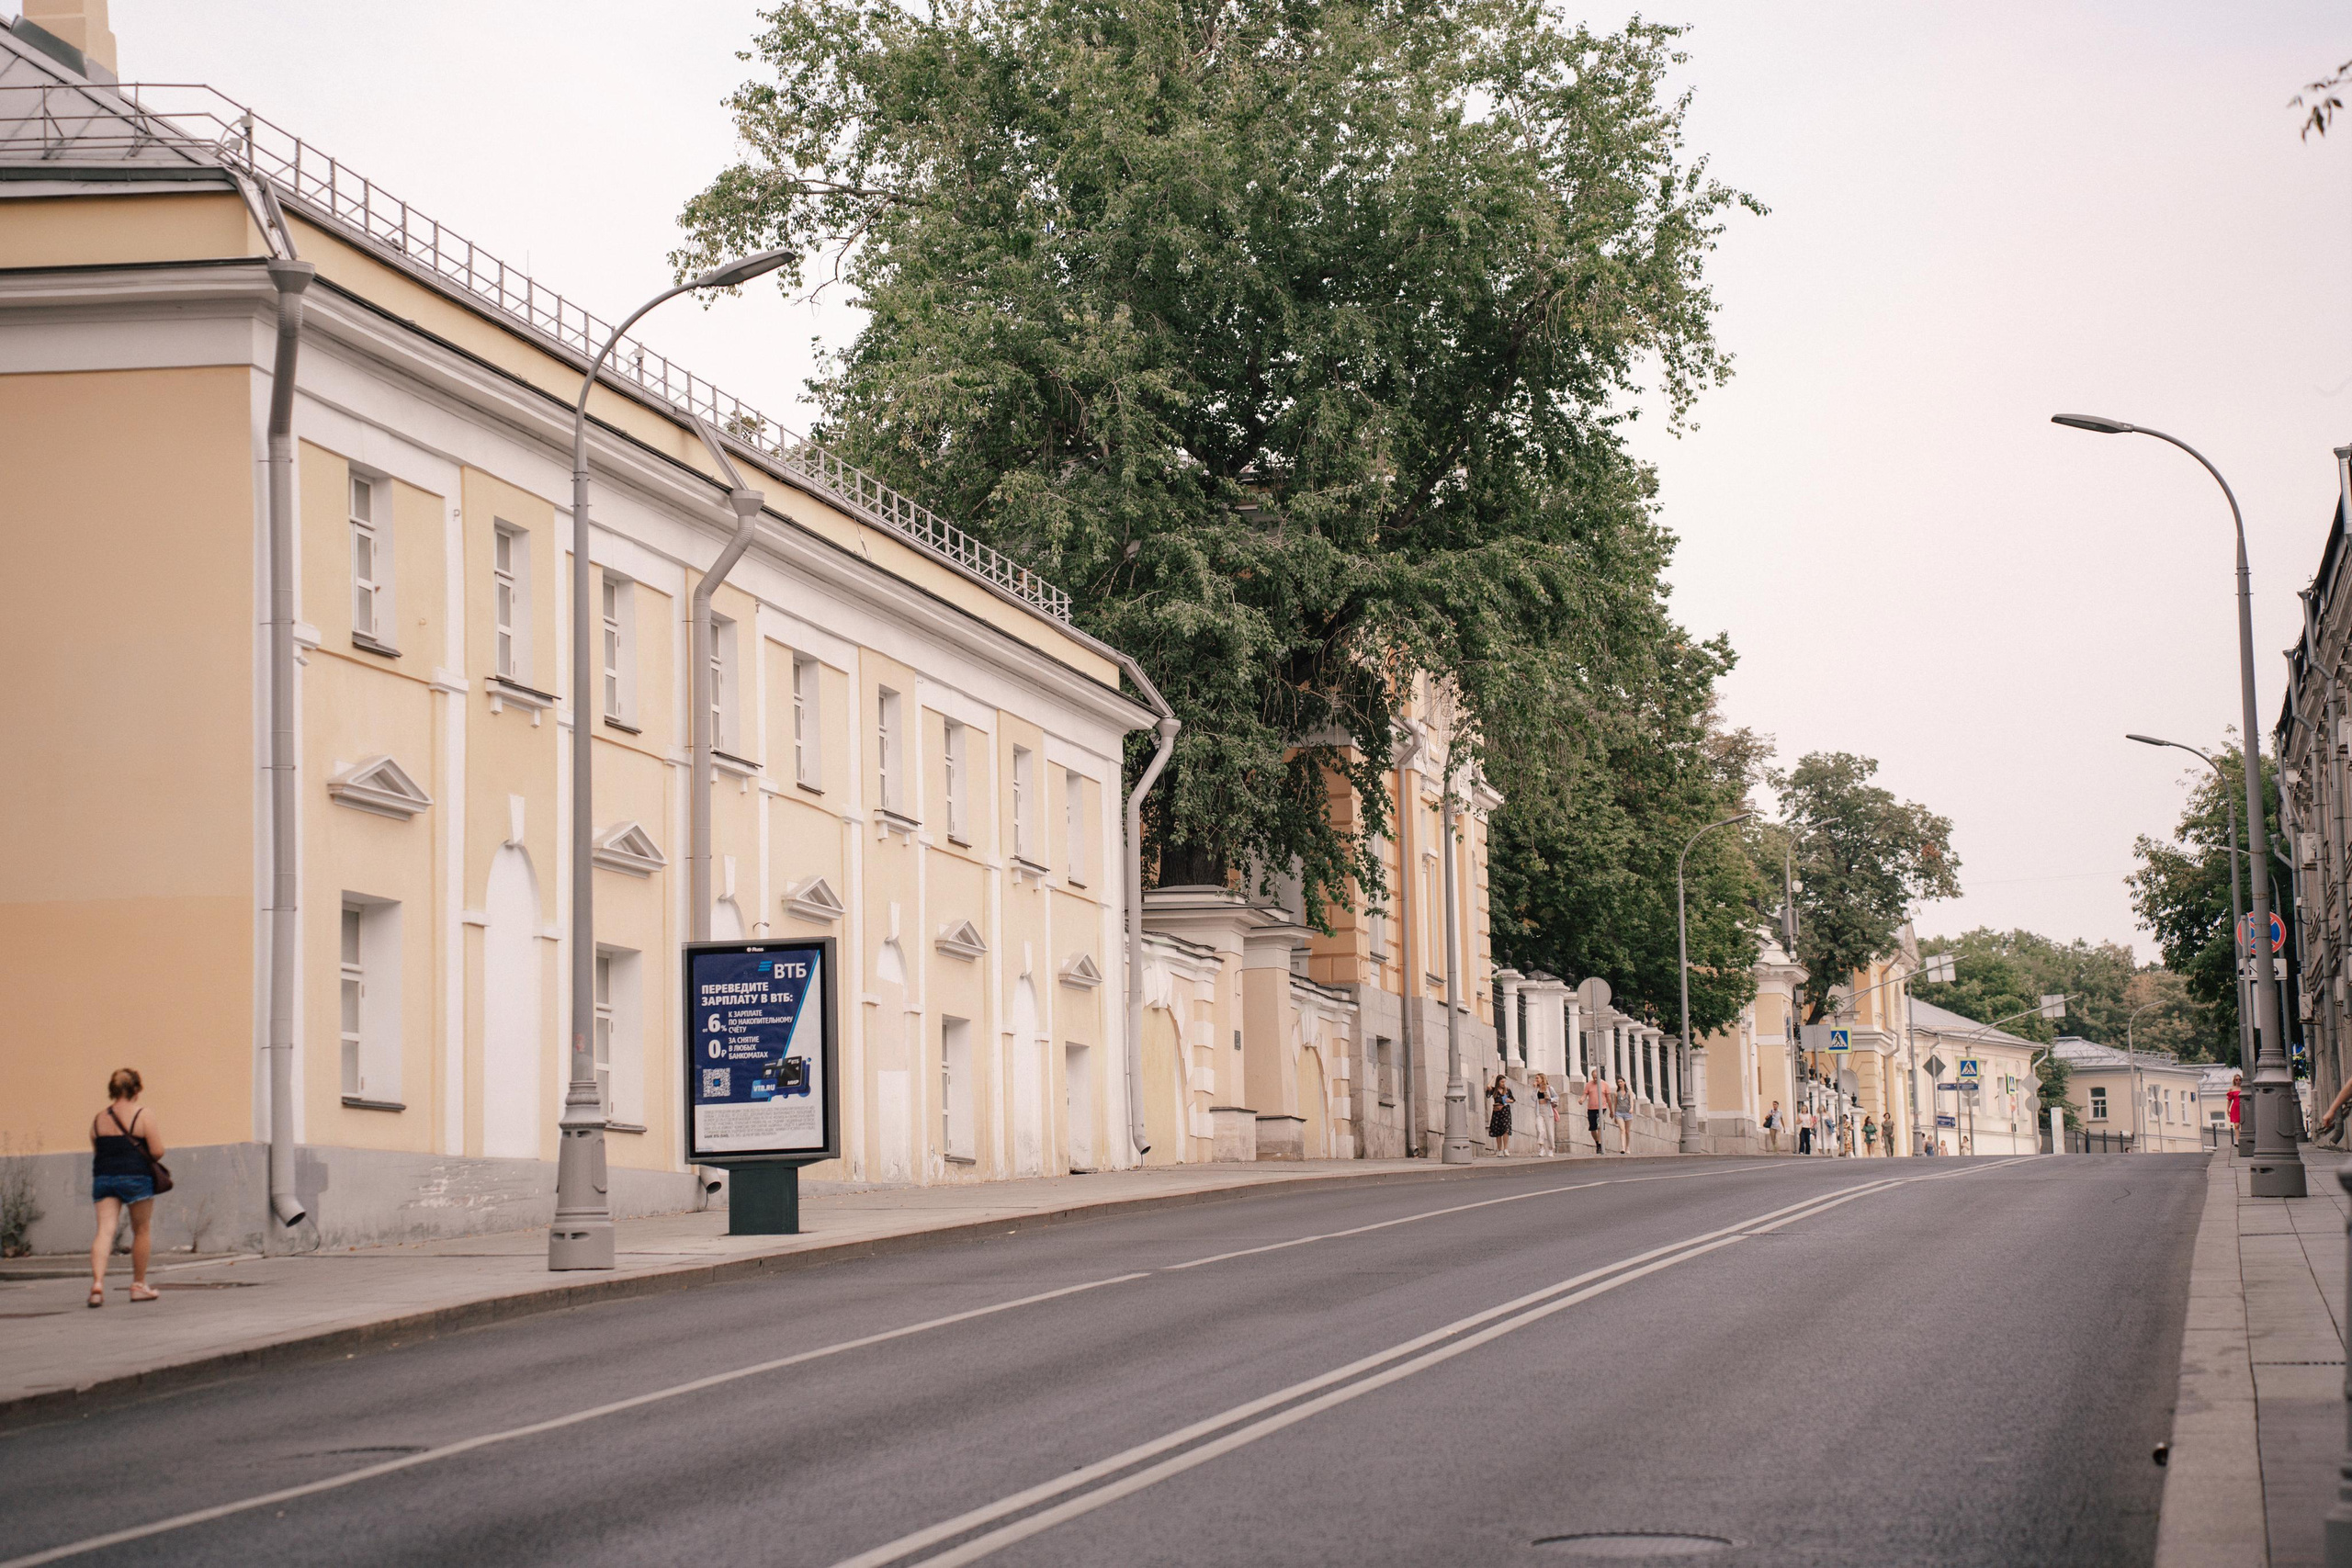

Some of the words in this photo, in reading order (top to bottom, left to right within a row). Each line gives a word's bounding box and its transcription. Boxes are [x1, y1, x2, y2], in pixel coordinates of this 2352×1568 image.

[774, 963, 808, 979] ВТБ
[701, 982, 769, 995] ПЕРЕВЕДИТЕ
[701, 994, 758, 1007] ЗАРПЛАТУ
[761, 993, 768, 1004] В
[770, 992, 794, 1003] ВТБ:
[733, 1010, 763, 1018] ЗАРПЛАТЕ
[738, 1016, 794, 1025] НАКОПИТЕЛЬНОМУ
[728, 1024, 747, 1033] СЧЁТУ
[737, 1035, 760, 1043] СНЯТИЕ
[733, 1043, 756, 1052] ЛЮБЫХ
[729, 1051, 768, 1060] БАНКОМАТАХ
[752, 1084, 775, 1092] VTB.RU
